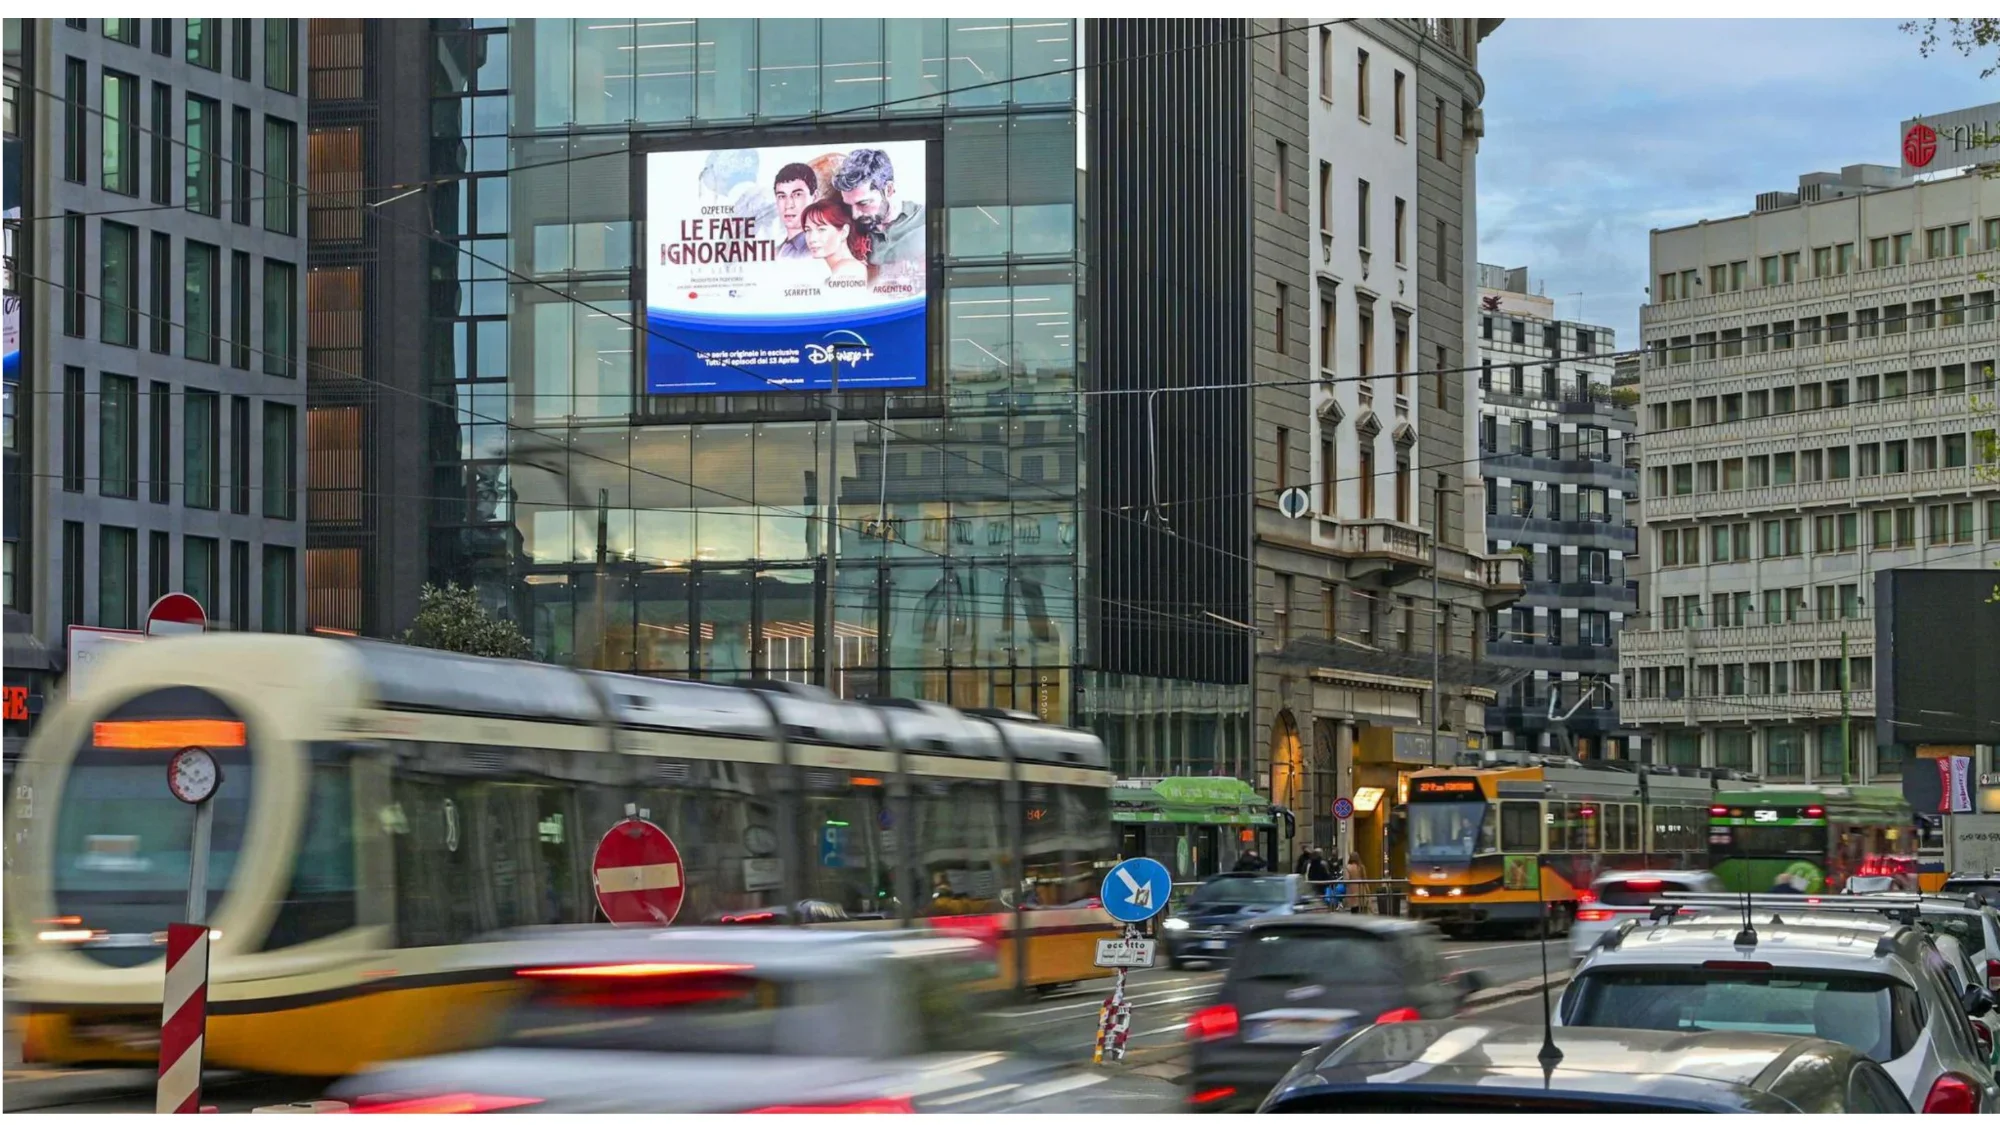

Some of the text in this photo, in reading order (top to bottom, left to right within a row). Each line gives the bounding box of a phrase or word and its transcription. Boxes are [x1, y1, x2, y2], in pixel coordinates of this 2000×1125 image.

[701, 205, 735, 215] OZPETEK
[681, 217, 756, 241] LE FATE
[660, 240, 776, 266] IGNORANTI
[784, 288, 821, 297] SCARPETTA
[873, 284, 913, 294] ARGENTERO
[778, 356, 800, 365] Aprile
[1107, 941, 1145, 949] ecctto
